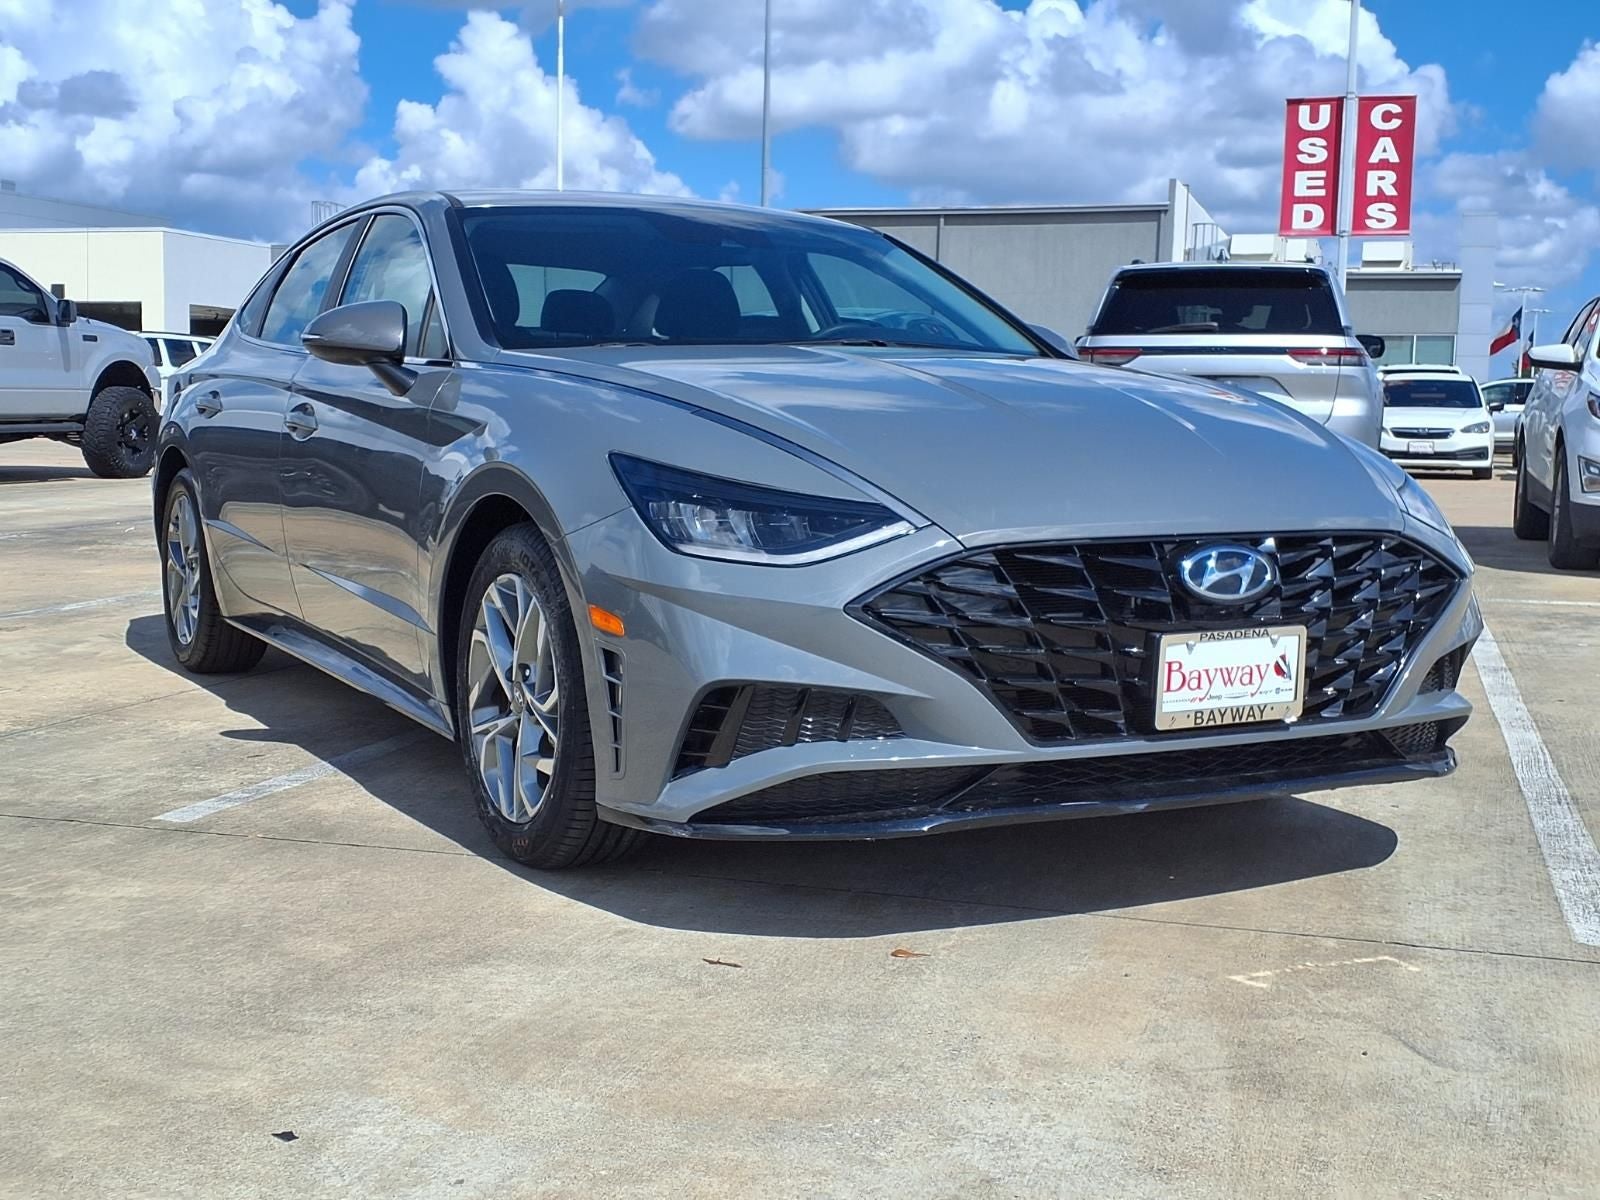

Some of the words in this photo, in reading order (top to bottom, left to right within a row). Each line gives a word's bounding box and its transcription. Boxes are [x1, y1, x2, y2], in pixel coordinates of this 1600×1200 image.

[1291, 104, 1331, 229] USED
[1365, 103, 1402, 229] CARS
[1200, 628, 1270, 641] PASADENA
[1164, 660, 1270, 703] Bayway
[1194, 704, 1267, 726] BAYWAY
